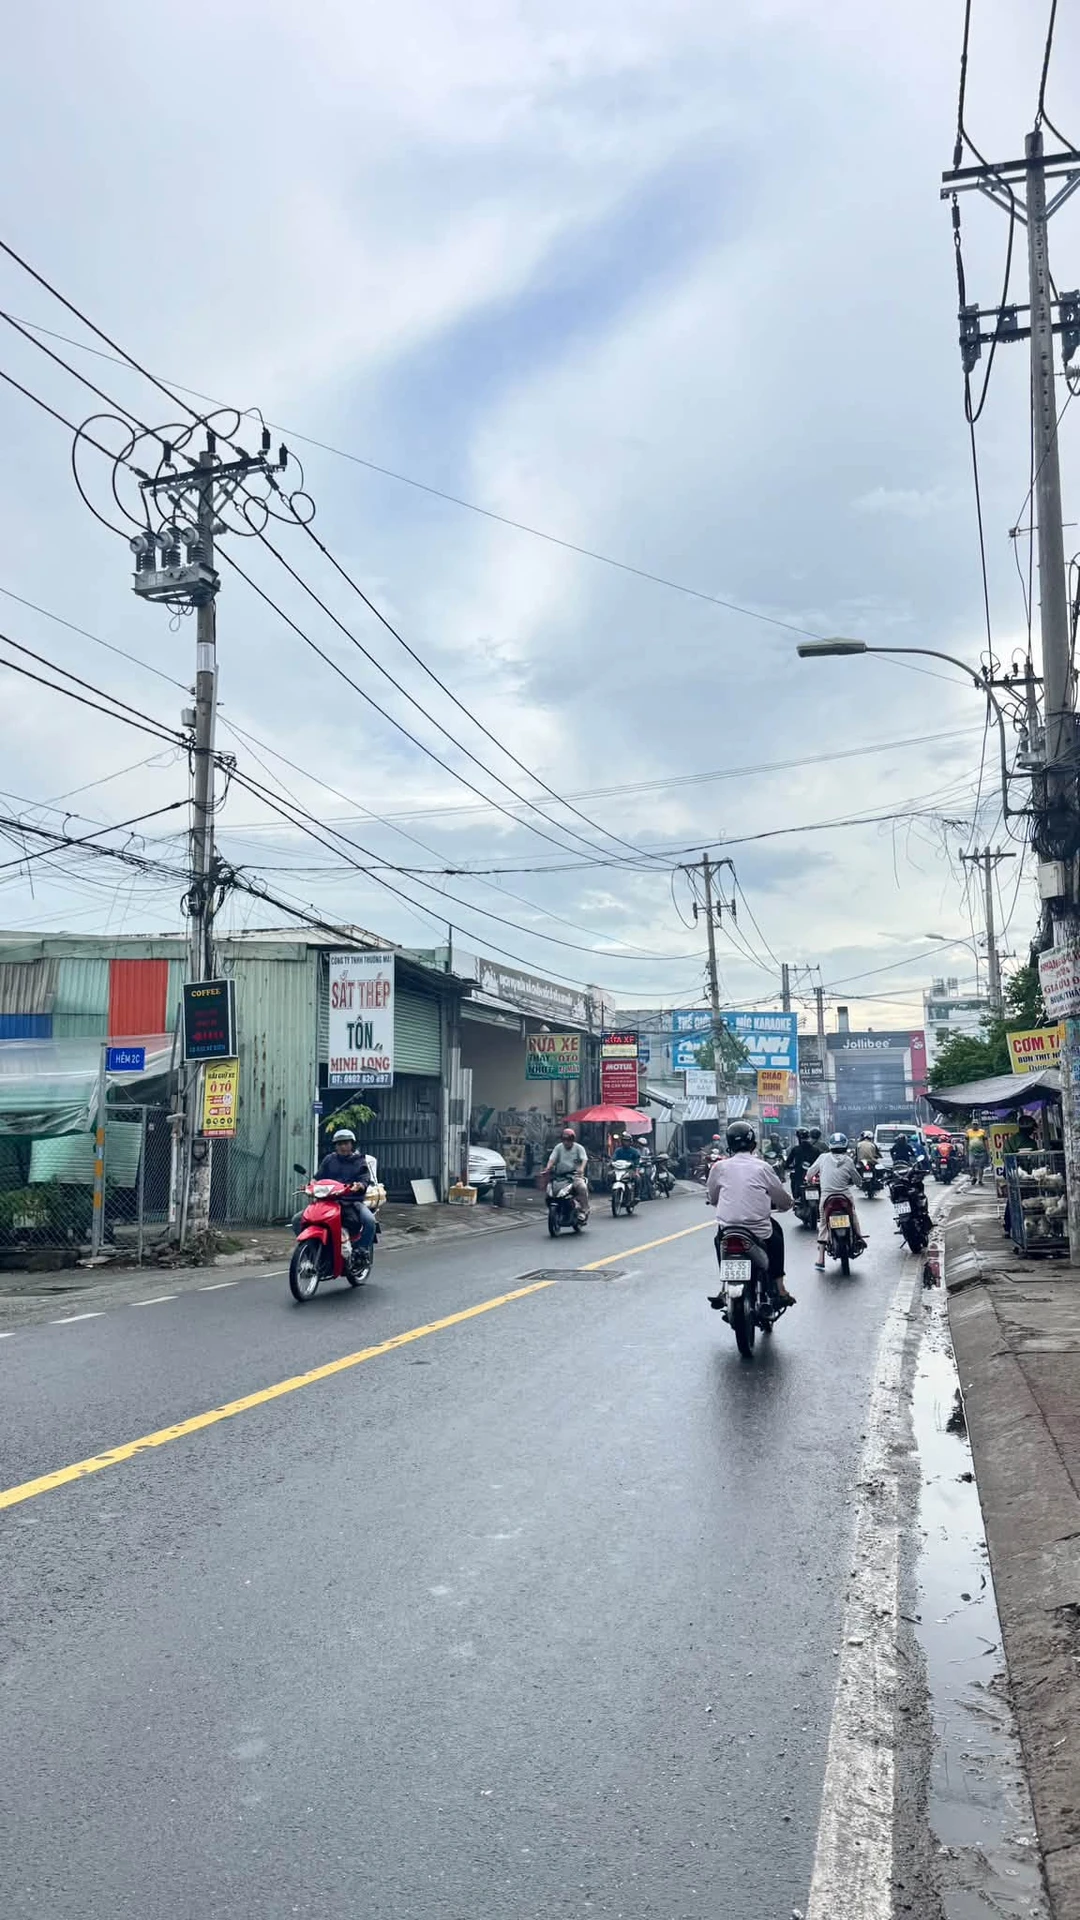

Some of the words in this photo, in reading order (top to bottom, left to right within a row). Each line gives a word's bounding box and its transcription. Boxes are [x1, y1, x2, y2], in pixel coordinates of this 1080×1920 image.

[191, 988, 222, 997] COFFEE
[331, 970, 355, 1009] SẮT
[359, 972, 391, 1009] THÉP
[753, 1017, 792, 1031] KARAOKE
[347, 1014, 373, 1050] TÔN
[561, 1036, 579, 1052] XE
[843, 1037, 889, 1049] Jollibee
[1013, 1036, 1045, 1053] CƠM
[115, 1050, 131, 1064] HẺM
[131, 1054, 141, 1064] 2C
[331, 1058, 358, 1072] MINH
[361, 1057, 390, 1073] LONG
[606, 1063, 633, 1071] MOTUL
